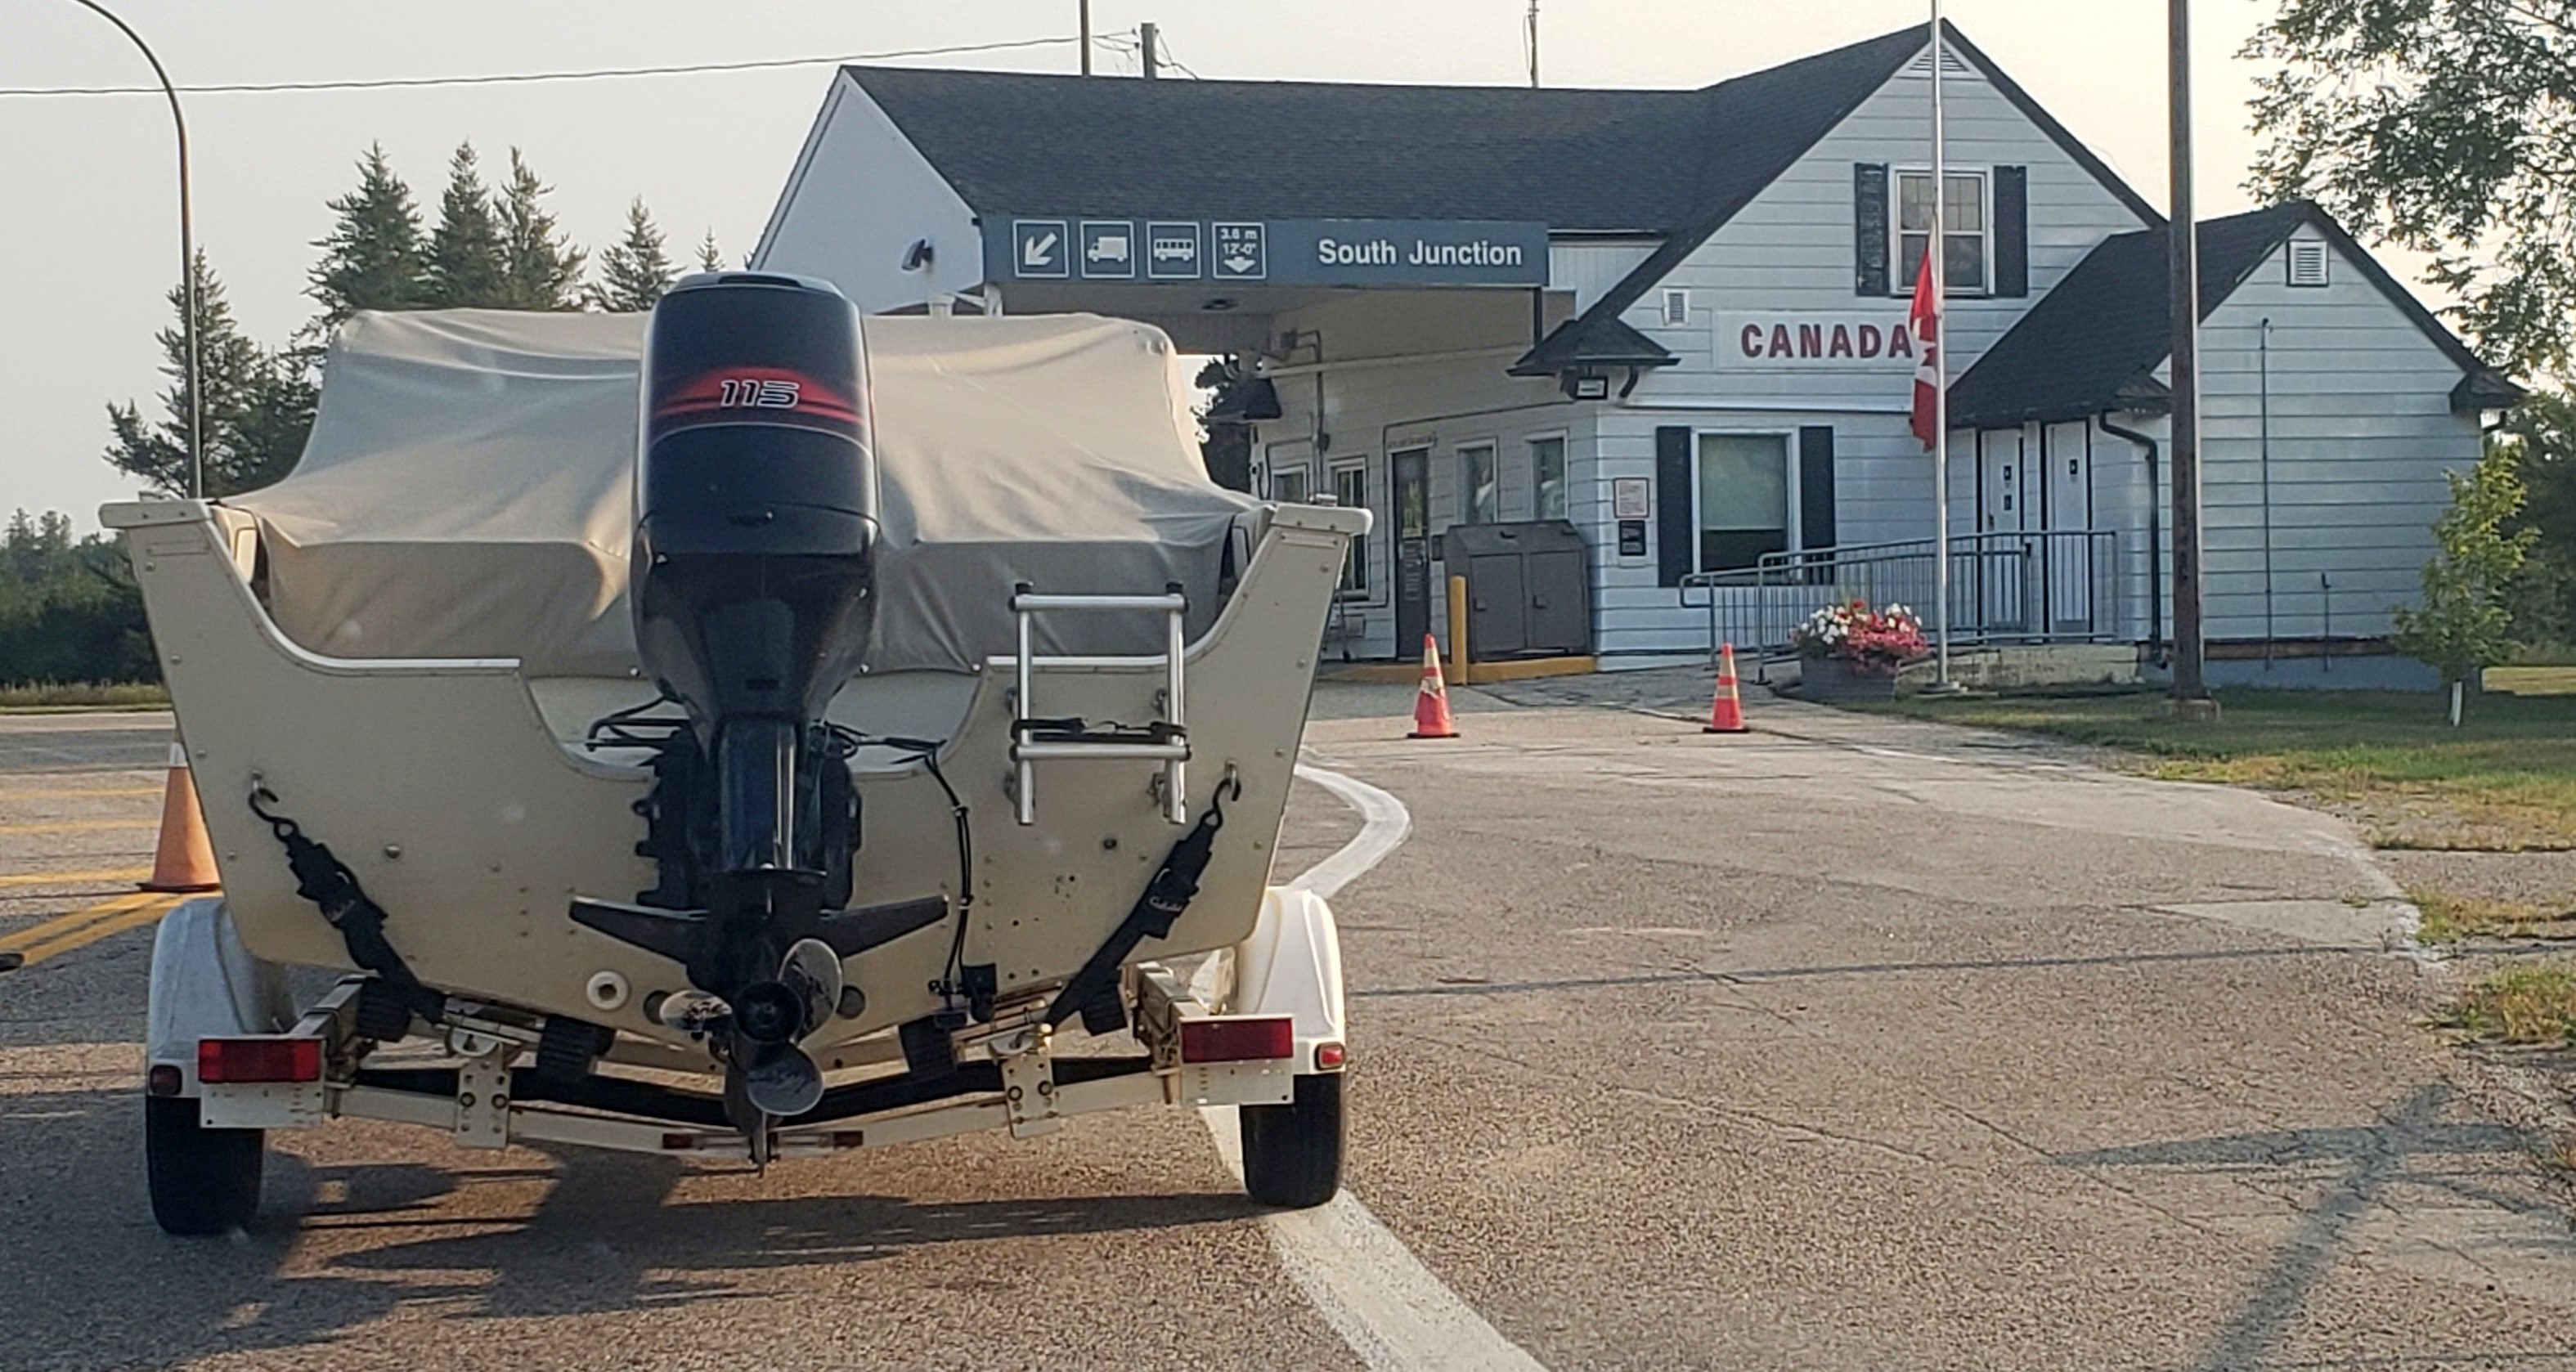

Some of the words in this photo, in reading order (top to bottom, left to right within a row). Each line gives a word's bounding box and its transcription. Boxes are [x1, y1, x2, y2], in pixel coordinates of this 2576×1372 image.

[1245, 230, 1258, 240] m
[1318, 239, 1398, 265] South
[1408, 240, 1522, 266] Junction
[1740, 323, 1913, 359] CANADA
[720, 379, 801, 409] 115
